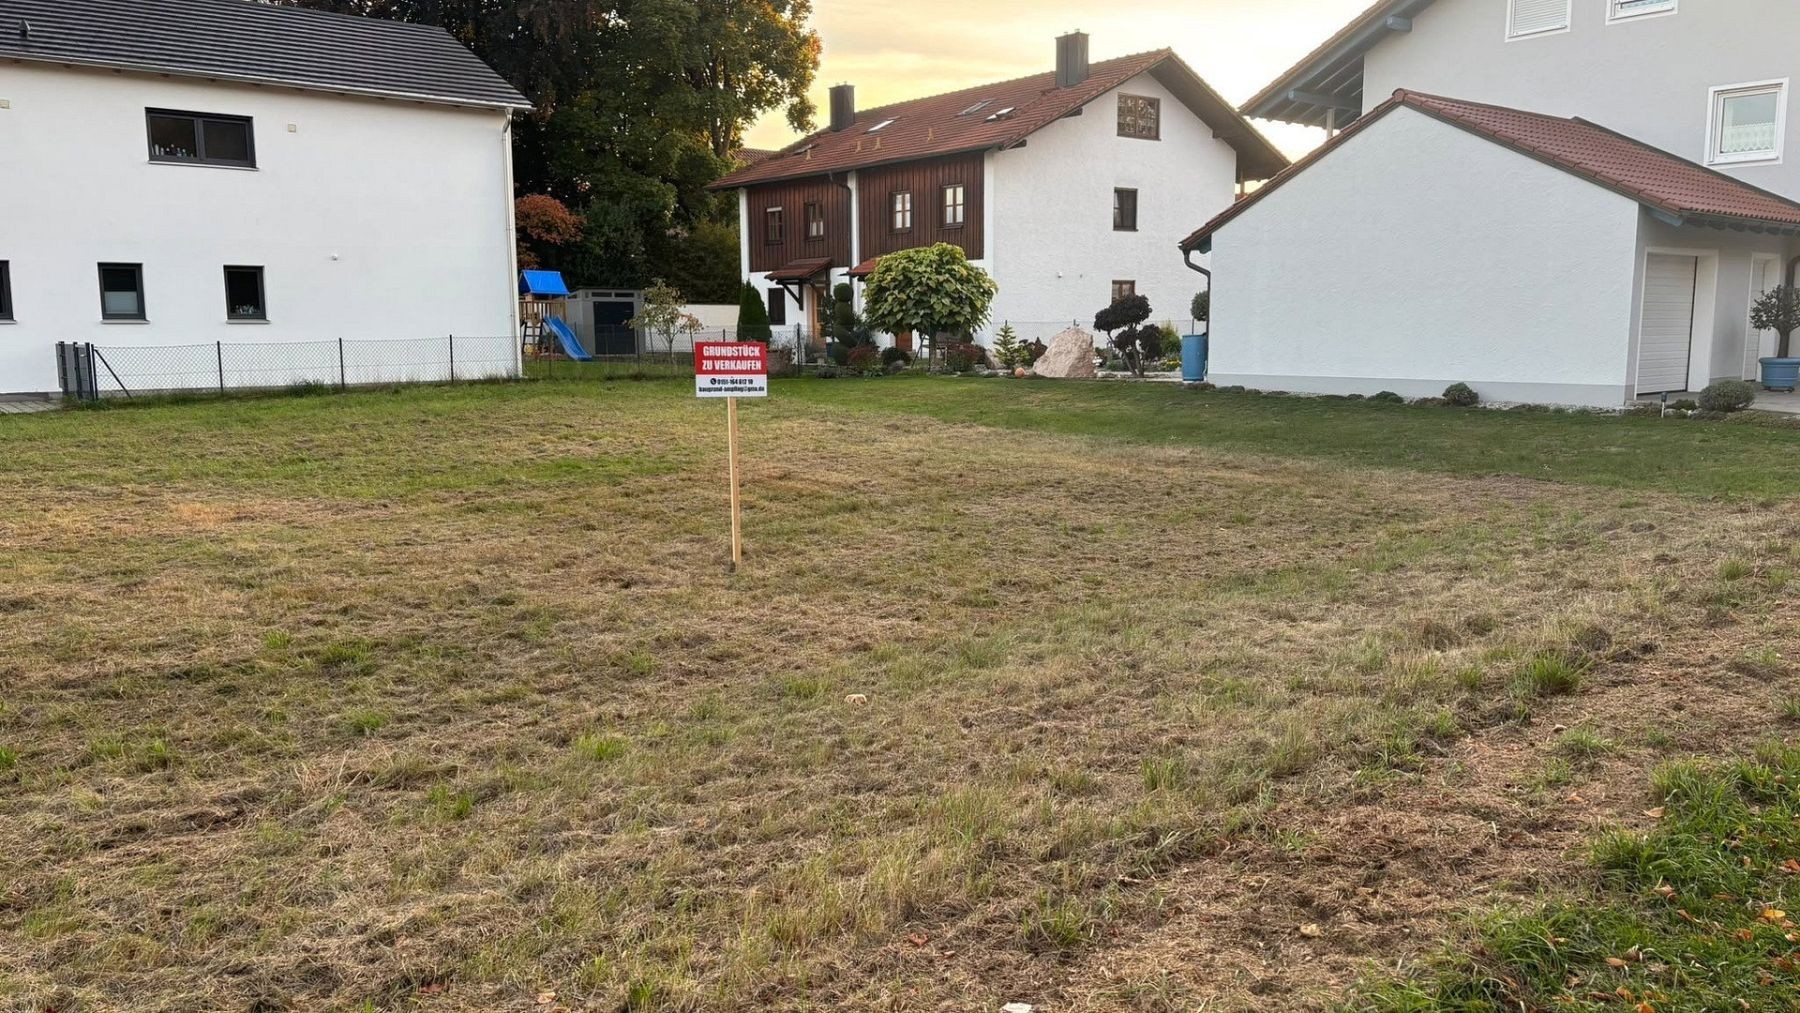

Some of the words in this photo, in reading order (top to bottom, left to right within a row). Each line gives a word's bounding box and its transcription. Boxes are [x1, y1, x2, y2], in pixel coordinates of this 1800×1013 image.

[703, 345, 760, 357] GRUNDSTÜCK
[702, 360, 712, 370] ZU
[714, 360, 762, 370] VERKAUFEN
